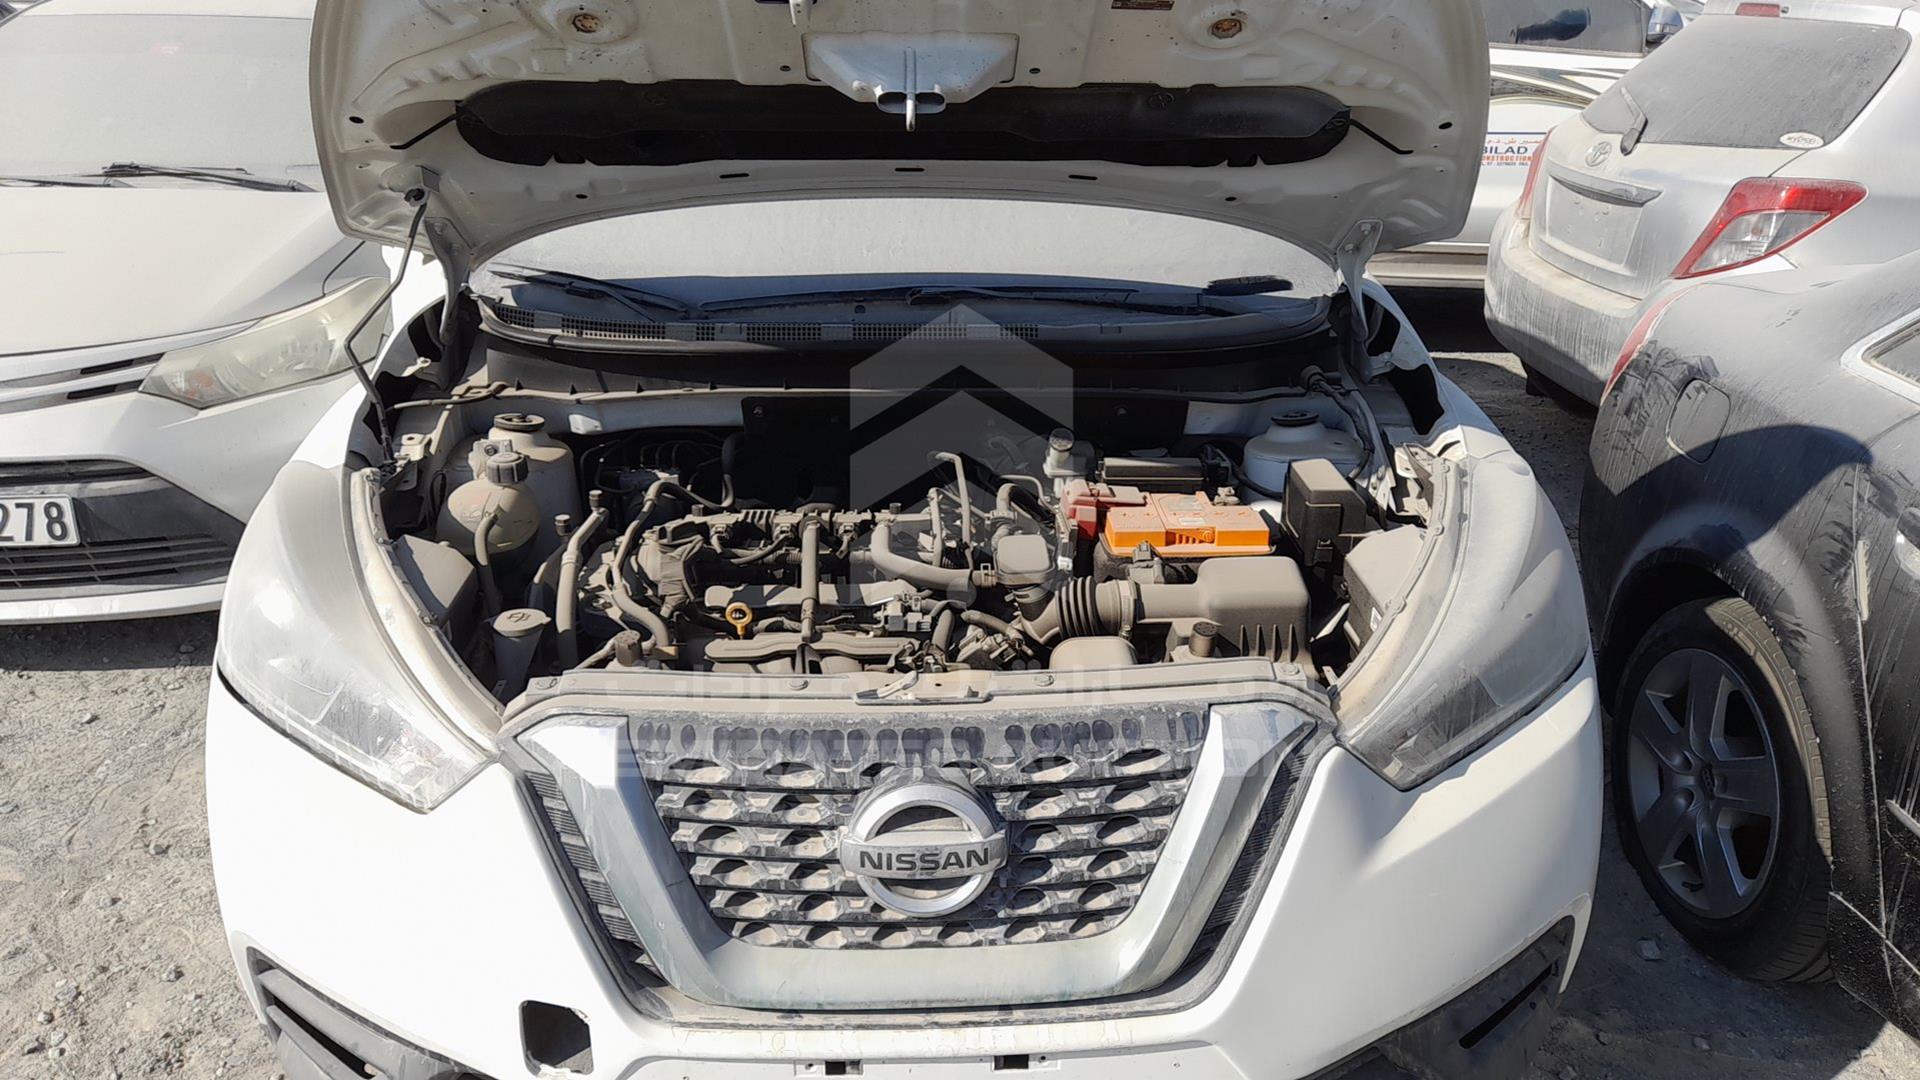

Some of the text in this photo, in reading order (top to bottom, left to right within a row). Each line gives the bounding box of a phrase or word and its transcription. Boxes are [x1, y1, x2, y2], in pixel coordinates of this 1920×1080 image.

[1482, 146, 1528, 154] BILAD
[0, 501, 67, 542] 278
[860, 848, 989, 871] NISSAN
